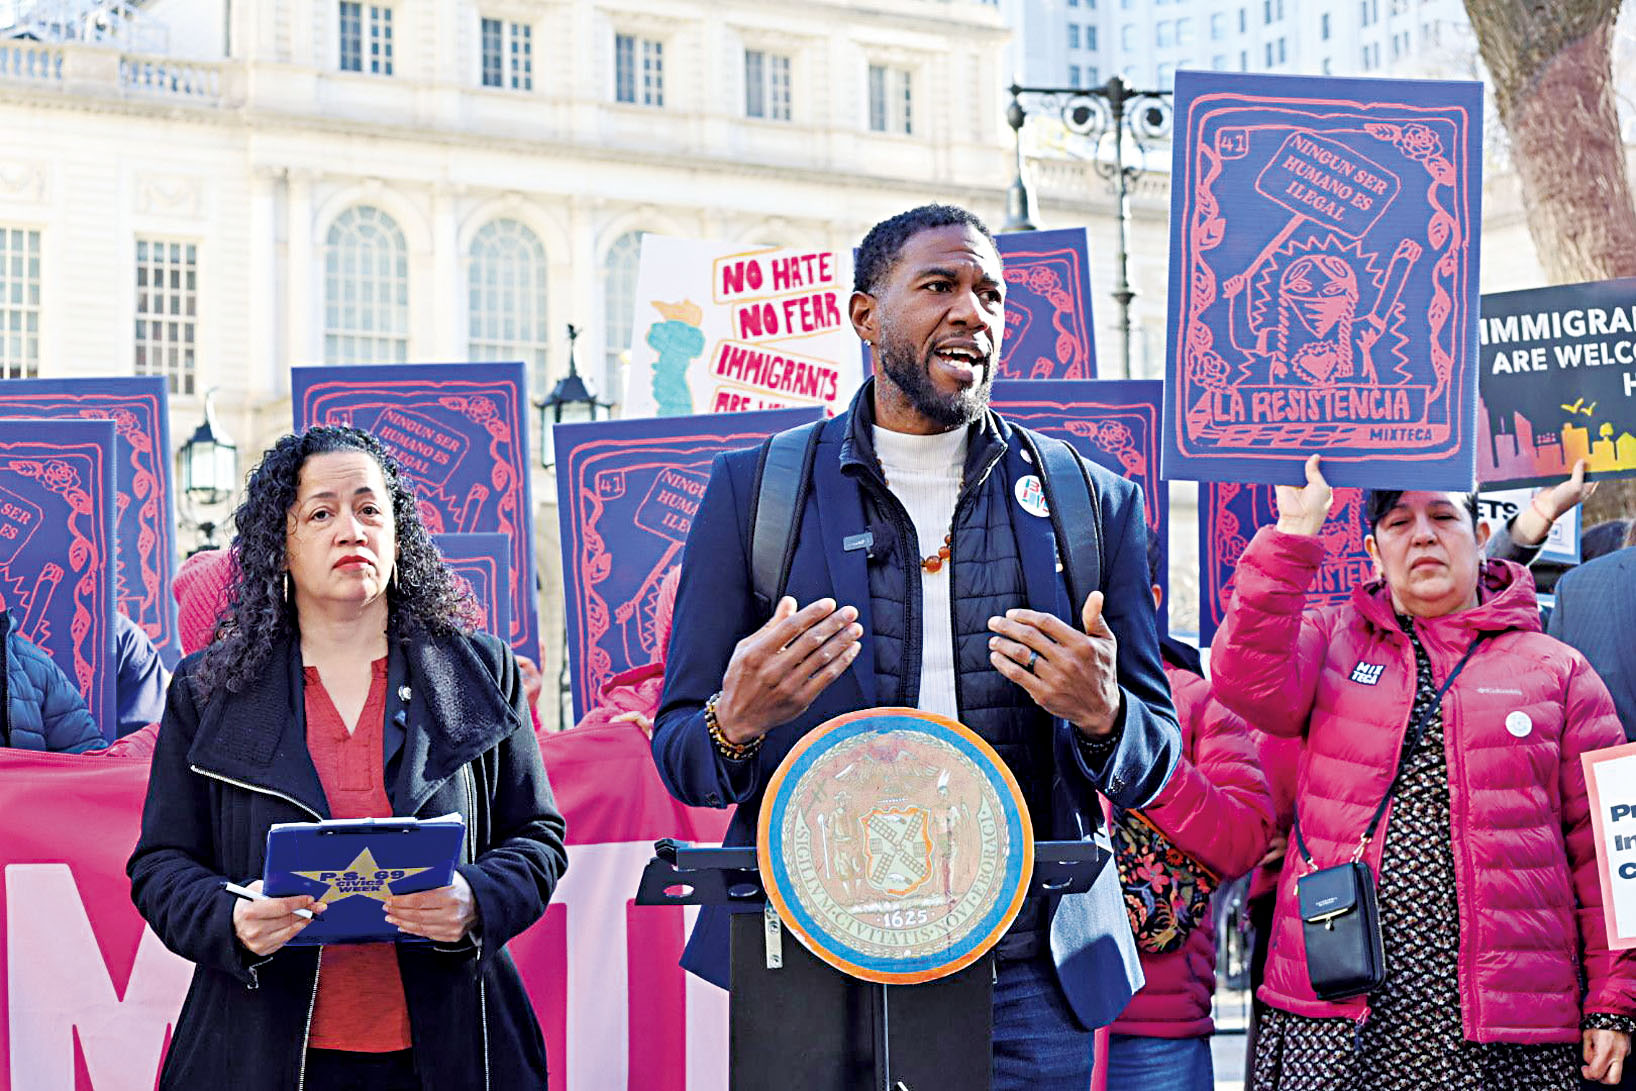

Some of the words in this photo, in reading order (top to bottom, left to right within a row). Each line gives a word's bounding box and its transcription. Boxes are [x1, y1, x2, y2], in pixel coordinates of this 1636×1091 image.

[1220, 135, 1245, 152] 41
[1290, 135, 1356, 177] NINGUN
[1354, 170, 1388, 195] SER
[1282, 155, 1353, 200] HUMANO
[1350, 192, 1373, 211] ES
[1285, 181, 1346, 221] ILEGAL
[723, 259, 763, 295] NO
[772, 252, 832, 291] HATE
[739, 302, 778, 339] NO
[783, 292, 840, 334] FEAR
[1005, 311, 1023, 326] ER
[1480, 306, 1636, 345] IMMIGRA
[717, 344, 838, 401] IMMIGRANTS
[1492, 348, 1548, 375] ARE
[1554, 341, 1636, 369] WELC
[1214, 387, 1246, 422] LA
[1252, 388, 1411, 422] RESISTENCIA
[379, 426, 434, 457] HUMANO
[432, 450, 450, 465] ES
[384, 410, 435, 439] NINGUN
[434, 433, 460, 453] SER
[1369, 428, 1433, 441] MIXTECA
[601, 477, 623, 493] 41
[662, 471, 707, 499] NING
[1, 503, 32, 525] SER
[662, 512, 690, 533] ILE
[1478, 499, 1518, 520] ETS
[1356, 661, 1384, 675] MIX
[320, 872, 366, 882] P.S.
[374, 870, 405, 880] 69
[883, 910, 928, 927] 1625
[936, 895, 972, 934] NOVI
